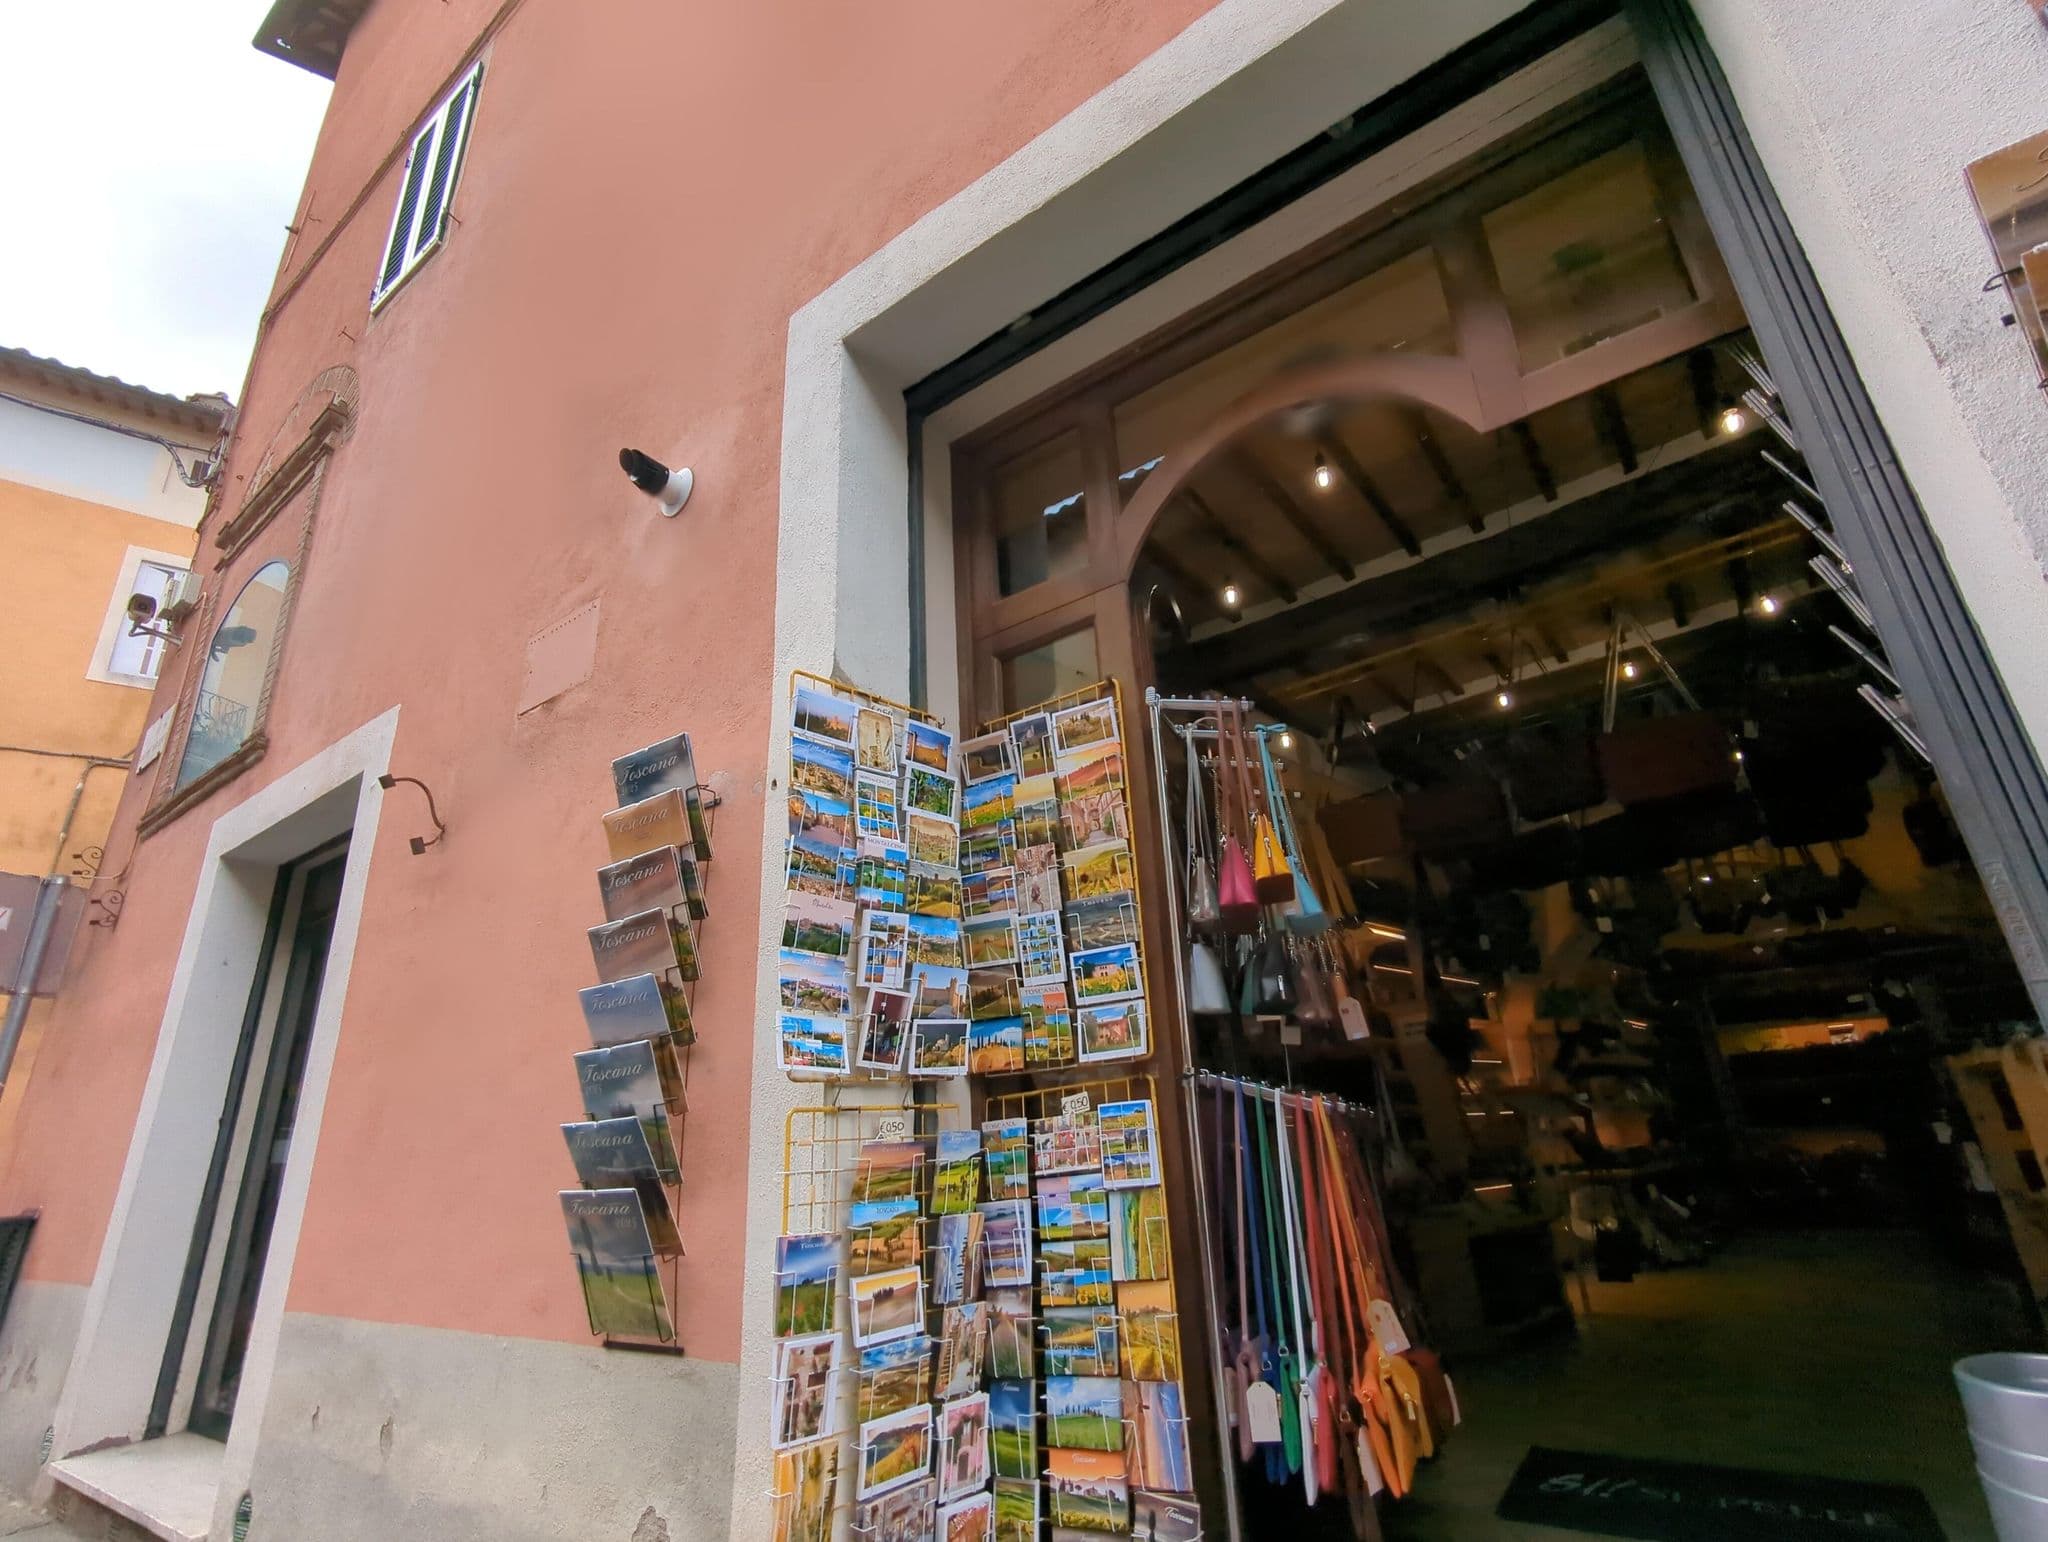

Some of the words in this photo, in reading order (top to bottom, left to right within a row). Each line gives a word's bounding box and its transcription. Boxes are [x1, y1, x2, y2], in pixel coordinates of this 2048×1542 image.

[618, 754, 679, 786] Toscana
[612, 806, 669, 834] Toscana
[605, 861, 665, 891] Toscana
[597, 924, 657, 951] Toscana
[591, 990, 649, 1010] Toscana
[582, 1064, 643, 1083] Toscana
[574, 1131, 634, 1148] Toscana
[568, 1199, 631, 1217] Toscana
